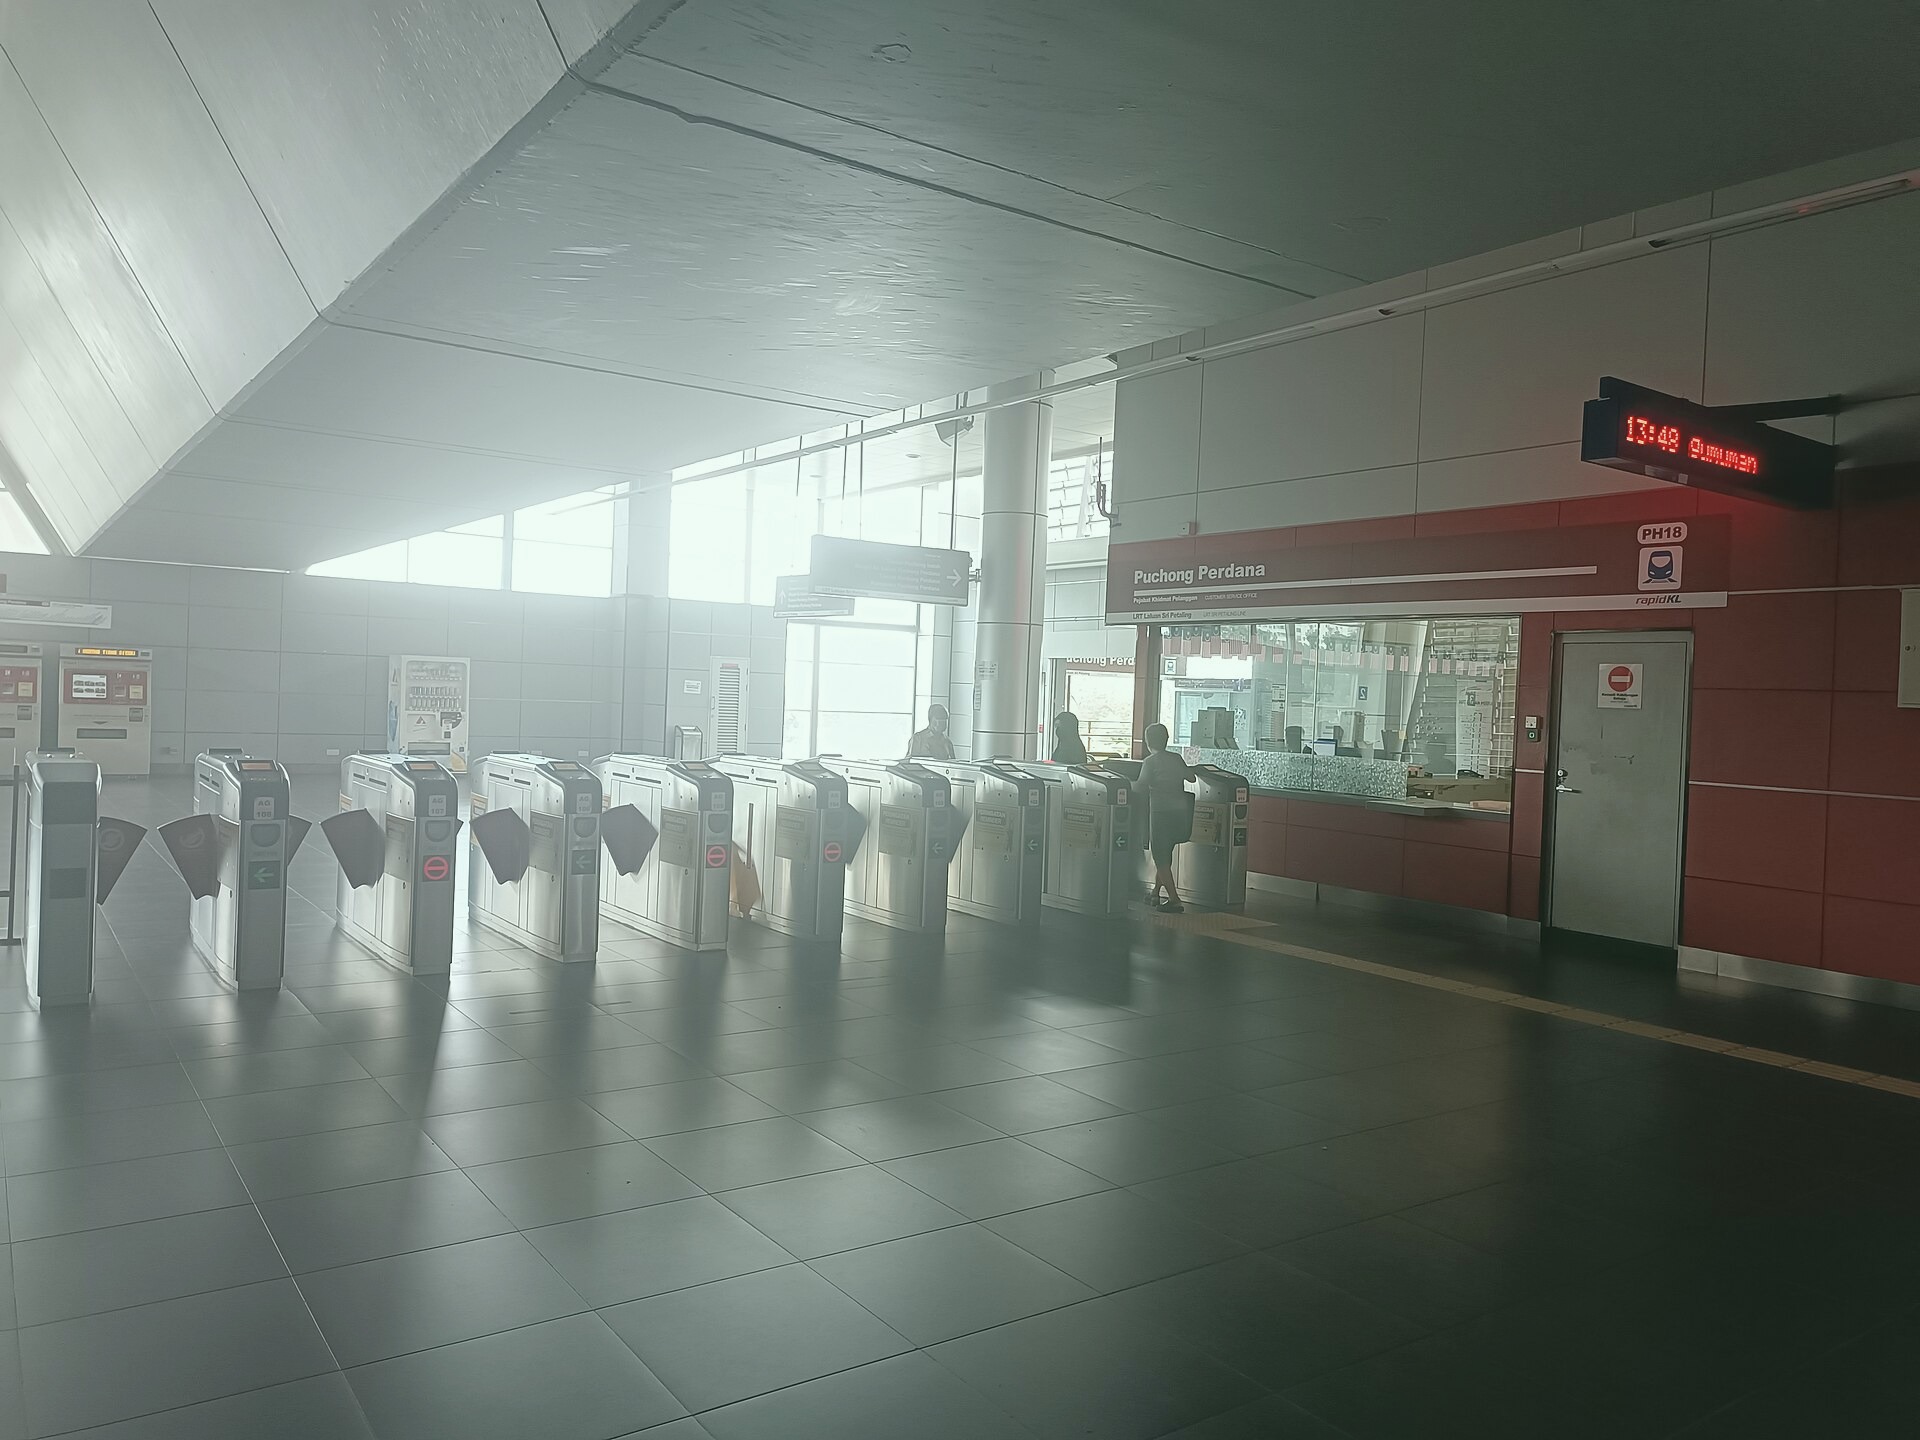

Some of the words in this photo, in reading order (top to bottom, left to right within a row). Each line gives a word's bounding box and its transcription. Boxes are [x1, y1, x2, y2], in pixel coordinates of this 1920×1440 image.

[1626, 416, 1680, 453] 13:48
[1642, 527, 1682, 540] PH18
[1134, 569, 1194, 584] Puchong
[1198, 563, 1265, 580] Perdana
[1636, 595, 1681, 606] rapidKL
